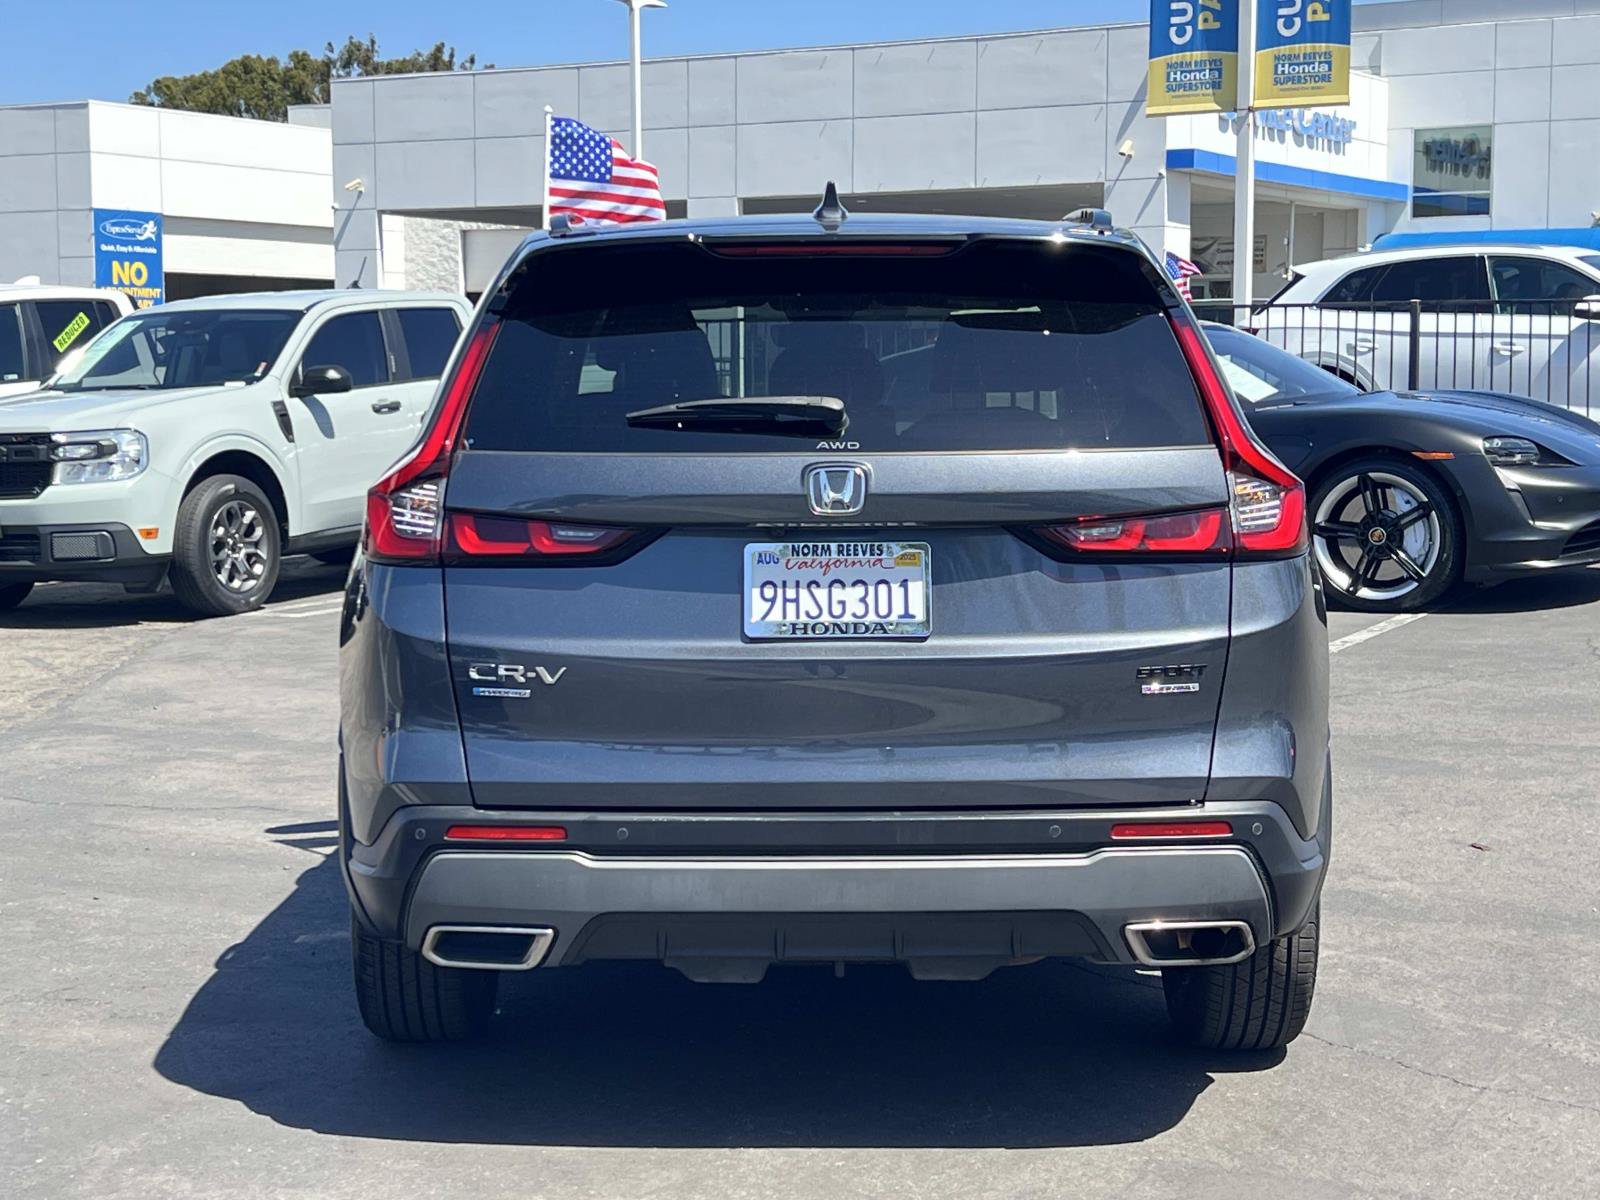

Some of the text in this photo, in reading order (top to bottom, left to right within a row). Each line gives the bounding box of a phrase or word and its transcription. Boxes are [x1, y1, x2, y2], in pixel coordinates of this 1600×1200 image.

[1274, 51, 1332, 63] NORM REEVES
[1166, 60, 1193, 70] NORM
[1277, 62, 1329, 74] Honda
[1170, 69, 1219, 82] Honda
[1273, 74, 1332, 86] SUPERSTORE
[1166, 81, 1222, 93] SUPERSTORE
[112, 260, 148, 286] NO
[57, 316, 86, 349] REDUCED
[816, 441, 860, 449] AWD
[791, 544, 883, 557] NORM REEVES
[757, 553, 780, 565] AUG
[784, 557, 895, 576] California
[759, 578, 917, 621] 9HSG301
[790, 622, 889, 635] HONDA
[468, 663, 567, 684] CR-V
